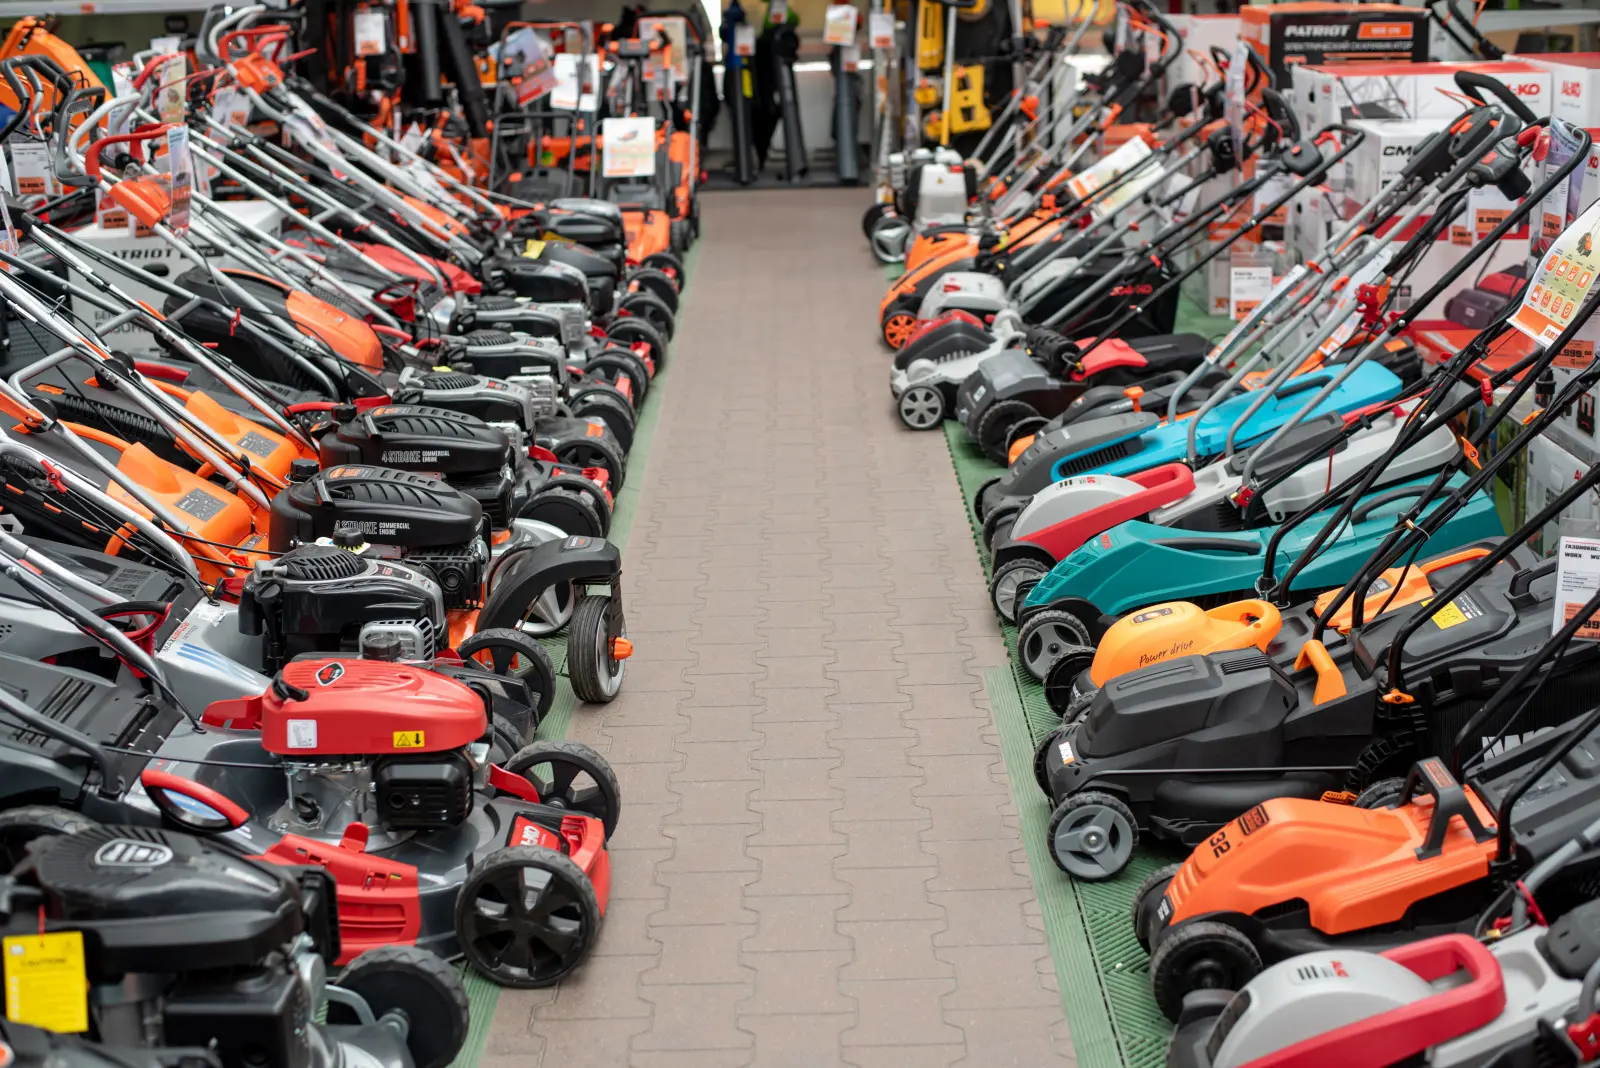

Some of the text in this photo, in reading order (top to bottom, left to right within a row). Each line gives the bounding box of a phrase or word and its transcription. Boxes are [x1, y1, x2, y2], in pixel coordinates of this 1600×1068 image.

[1284, 25, 1350, 38] PATRIOT
[379, 521, 410, 530] COMMERCIAL
[1564, 551, 1582, 559] WORX
[1139, 640, 1194, 668] Power drive
[1209, 831, 1232, 859] 32
